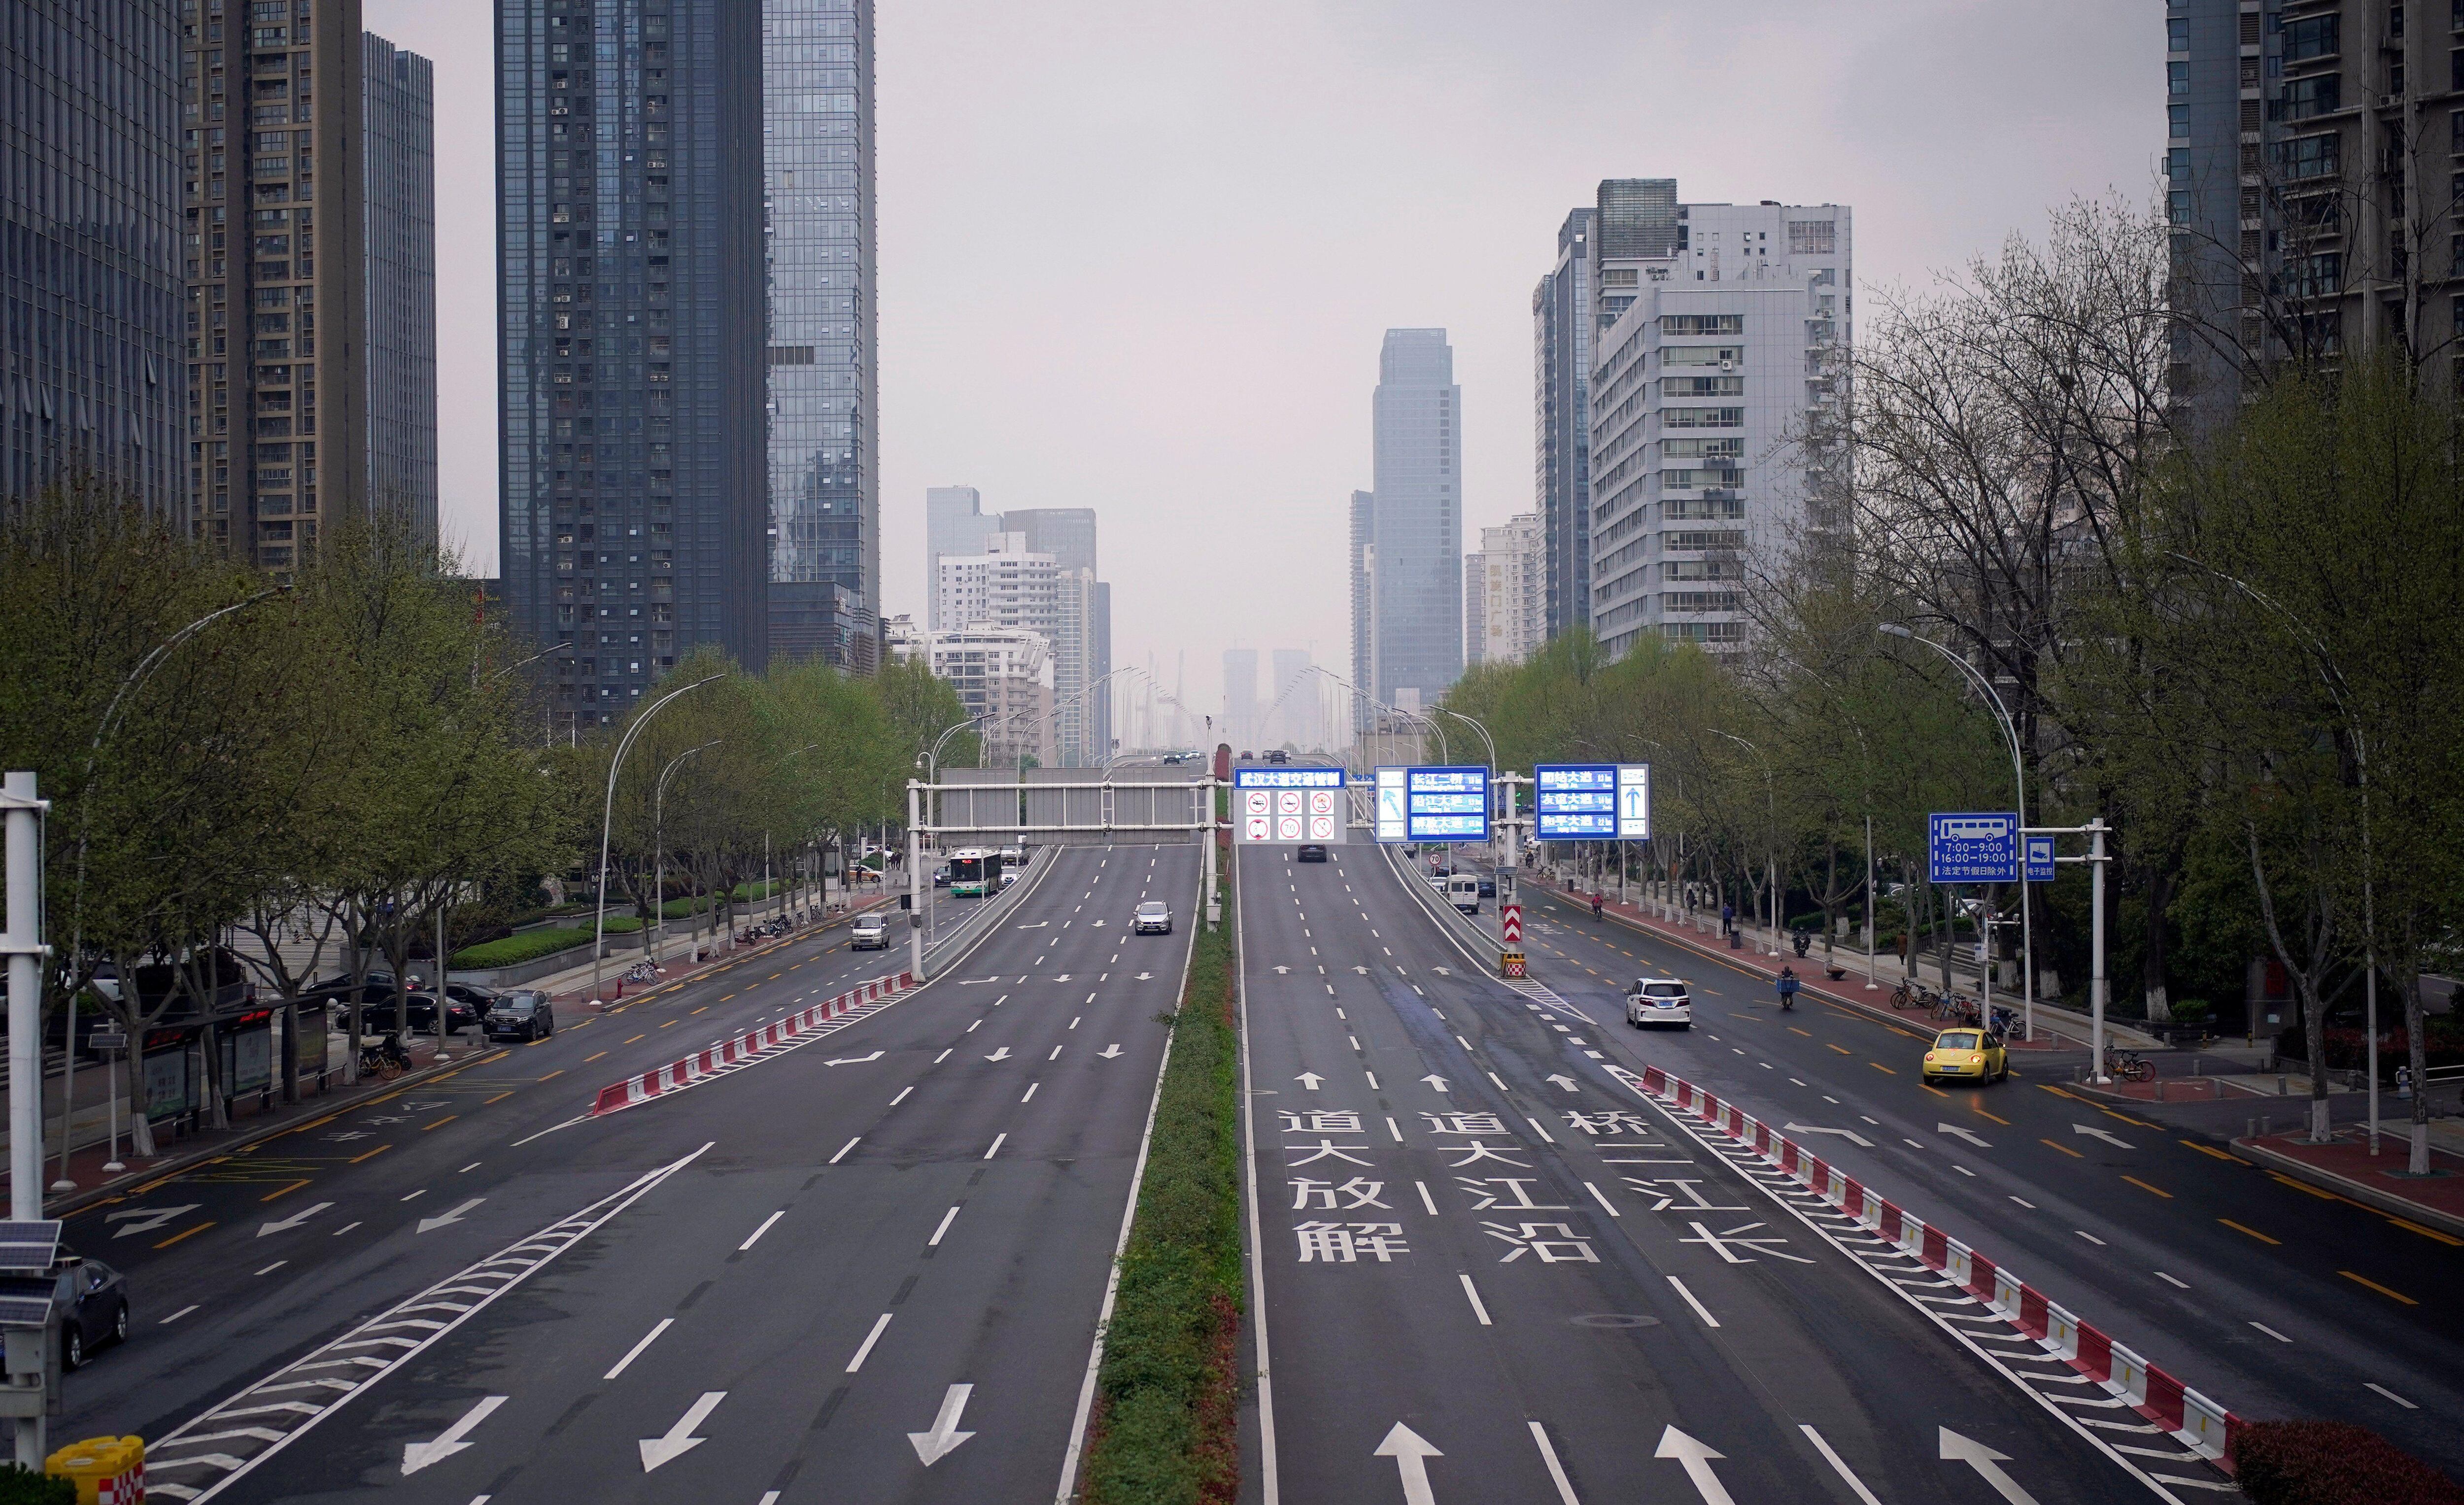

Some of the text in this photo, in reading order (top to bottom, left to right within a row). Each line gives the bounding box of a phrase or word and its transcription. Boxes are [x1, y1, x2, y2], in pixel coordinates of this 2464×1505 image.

[1490, 565, 1503, 637] 凯旋门广场
[1412, 773, 1463, 785] 长江二桥
[1412, 795, 1463, 806] 沿江大道
[1541, 815, 1593, 826] 和平大道
[1285, 824, 1295, 833] 70
[1942, 866, 2006, 876] 法定节假日除外
[2027, 867, 2053, 876] 电子监控
